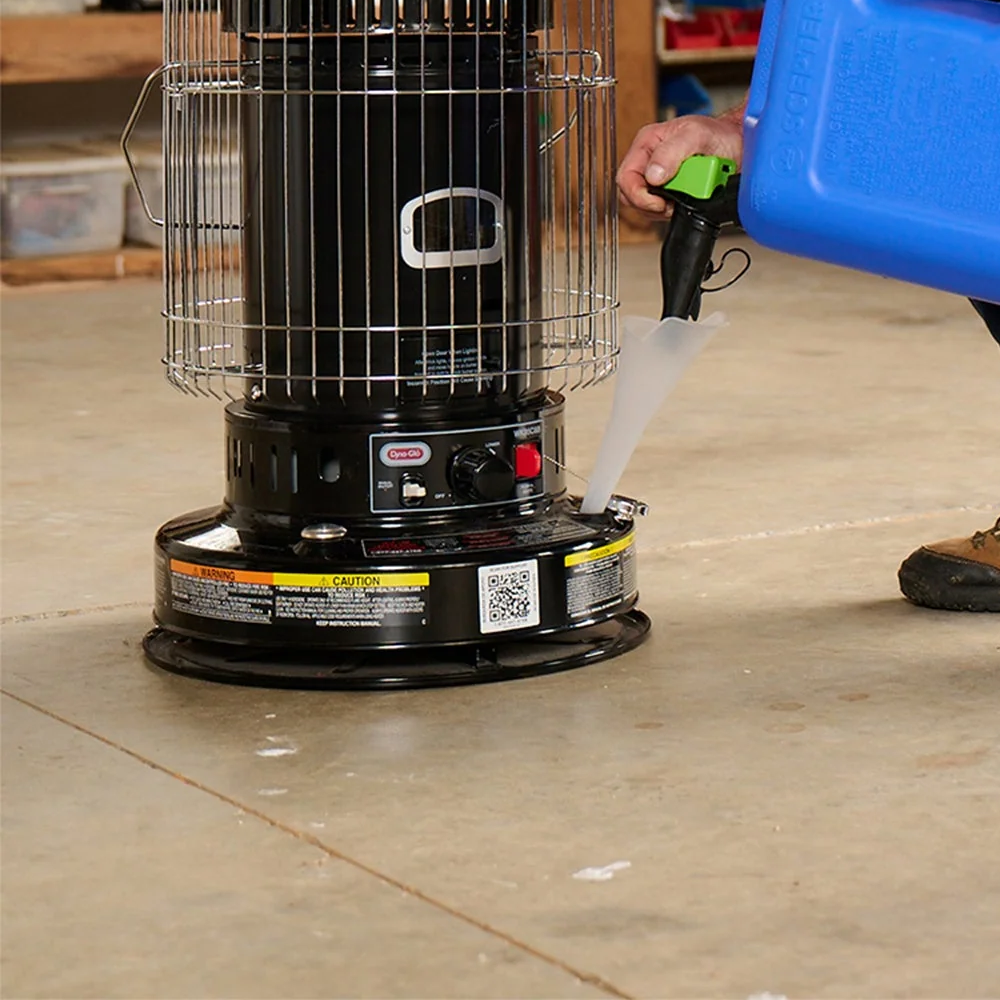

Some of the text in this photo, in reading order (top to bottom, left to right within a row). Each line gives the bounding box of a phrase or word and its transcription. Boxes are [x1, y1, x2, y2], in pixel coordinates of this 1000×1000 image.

[779, 0, 825, 136] SCEPTER
[200, 567, 236, 580] WARNING
[332, 576, 381, 586] CAUTION
